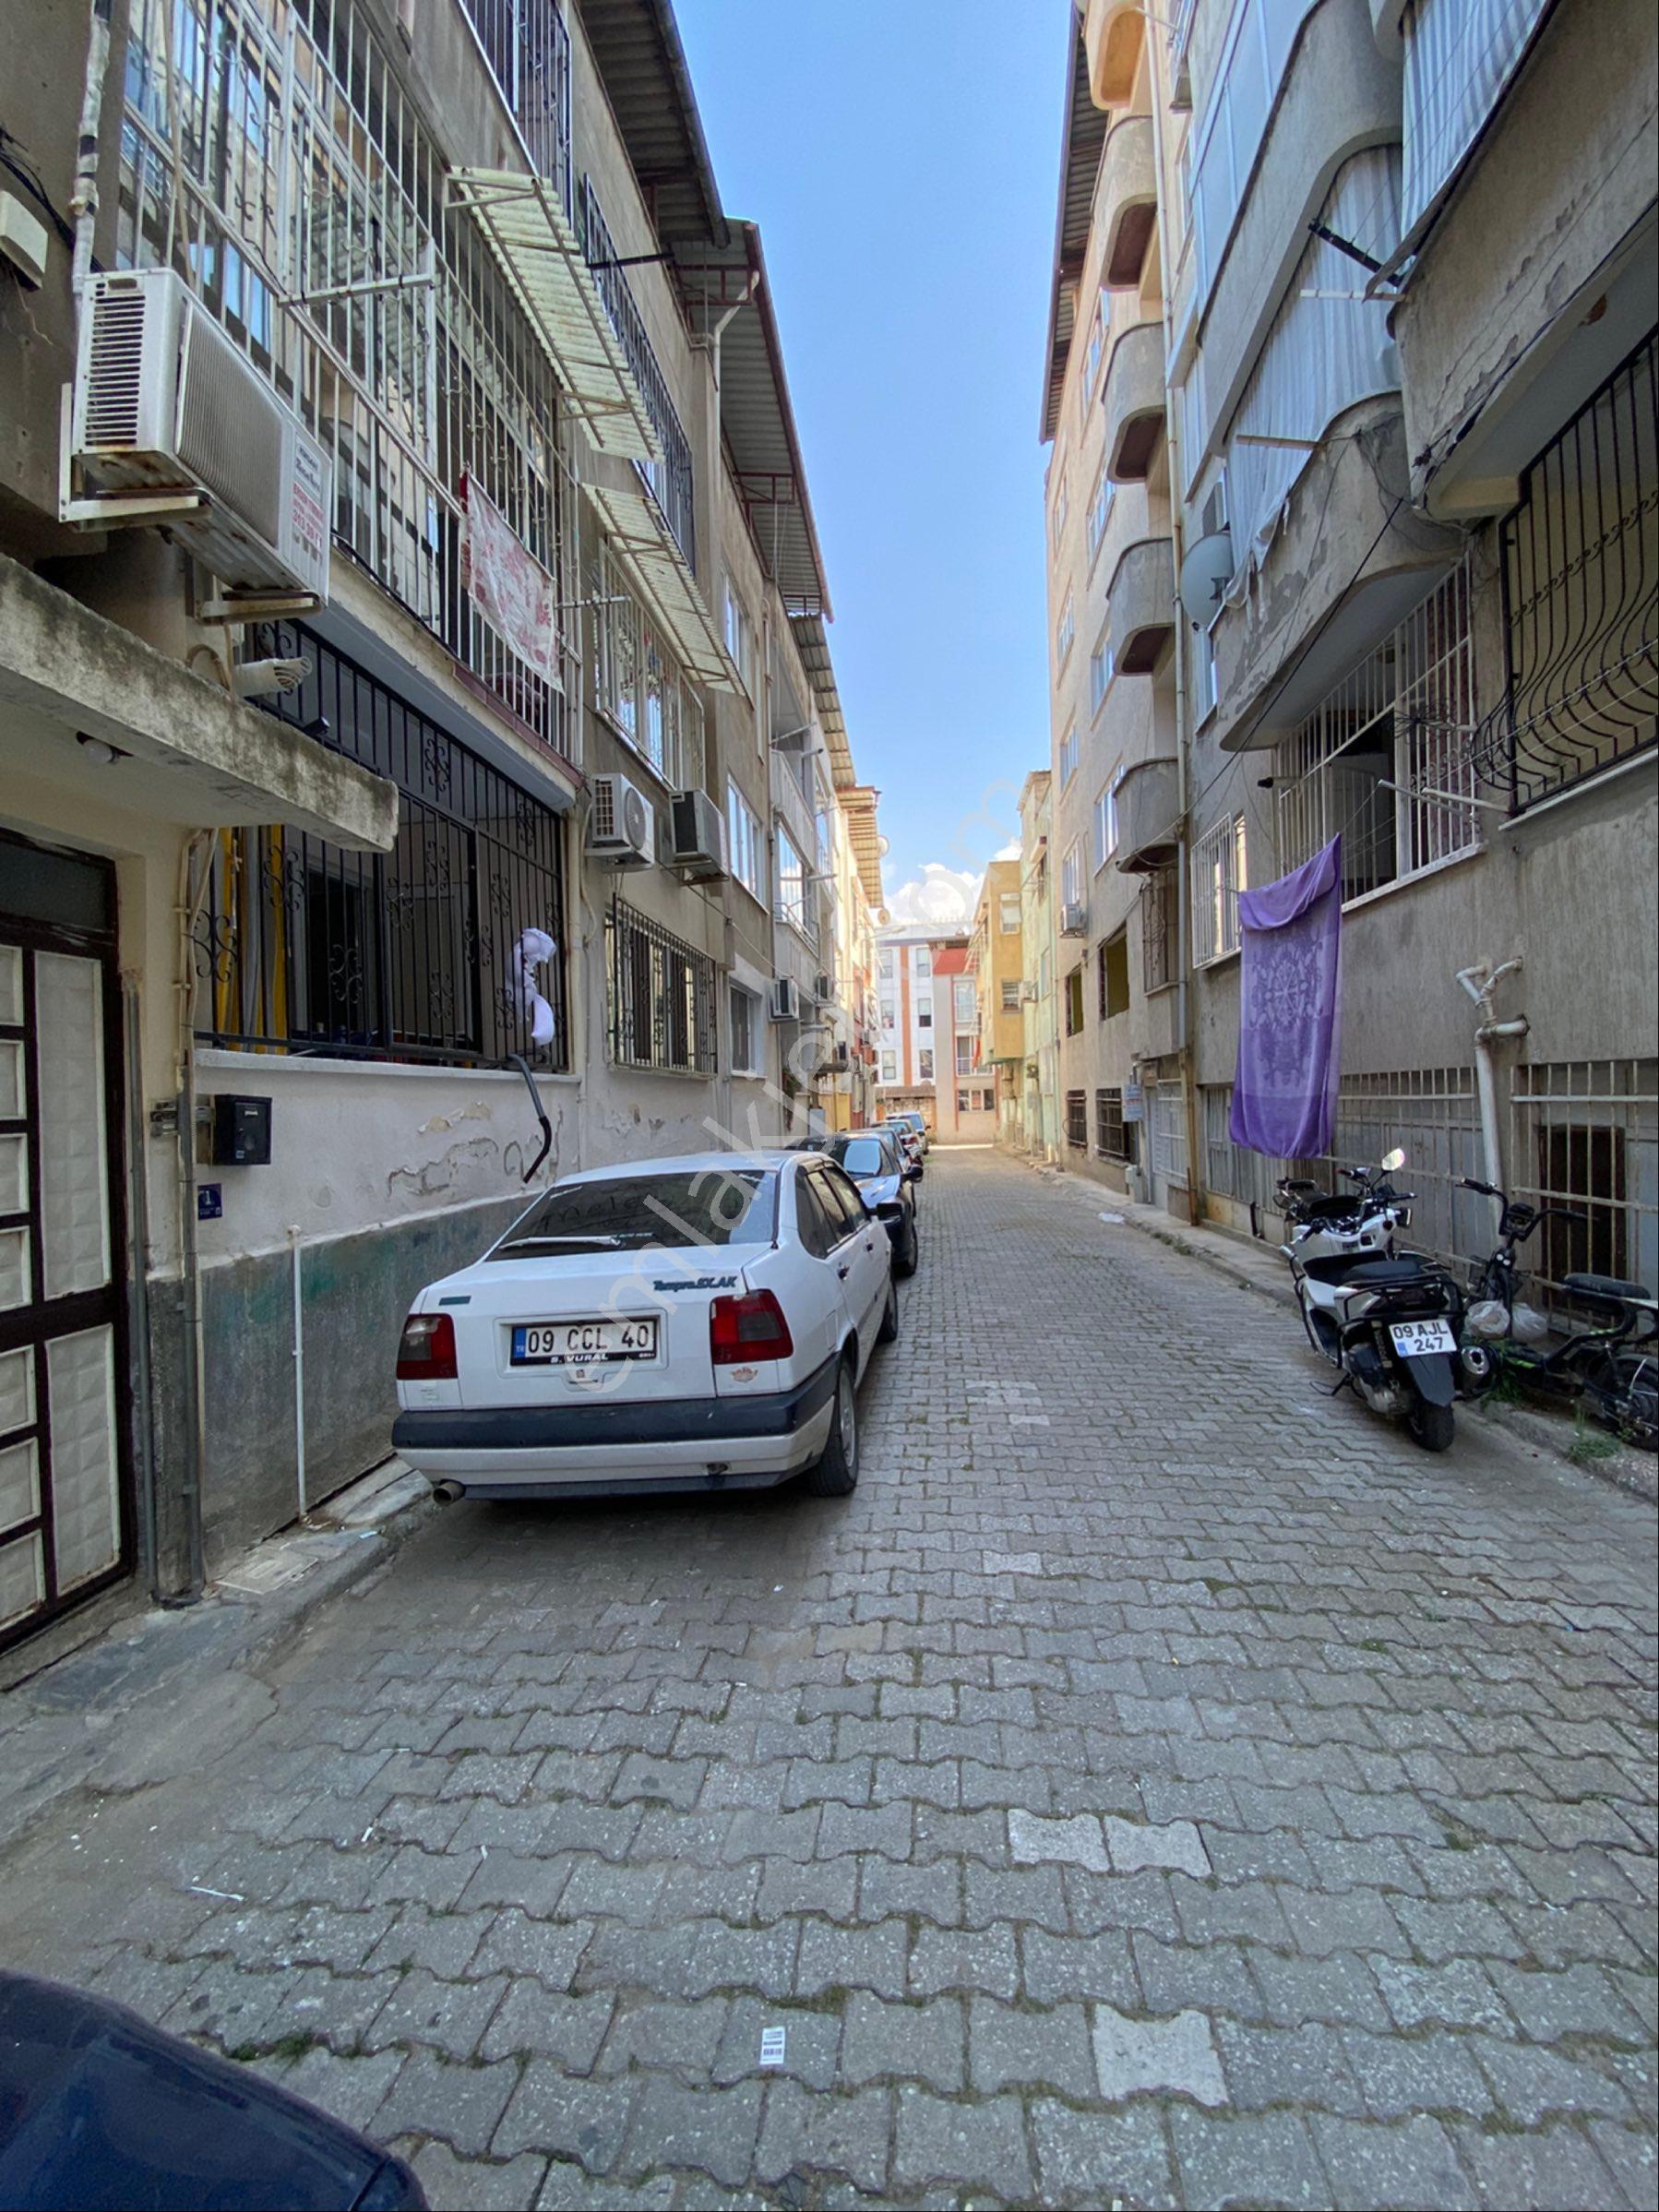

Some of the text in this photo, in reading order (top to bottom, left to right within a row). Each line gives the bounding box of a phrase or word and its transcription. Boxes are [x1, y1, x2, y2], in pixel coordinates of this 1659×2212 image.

[528, 1330, 554, 1353] 09
[567, 1327, 607, 1350] CCL
[621, 1324, 649, 1348] 40
[1393, 1321, 1448, 1339] 09 AJL
[1414, 1336, 1443, 1352] 247
[566, 1353, 609, 1362] VURAL
